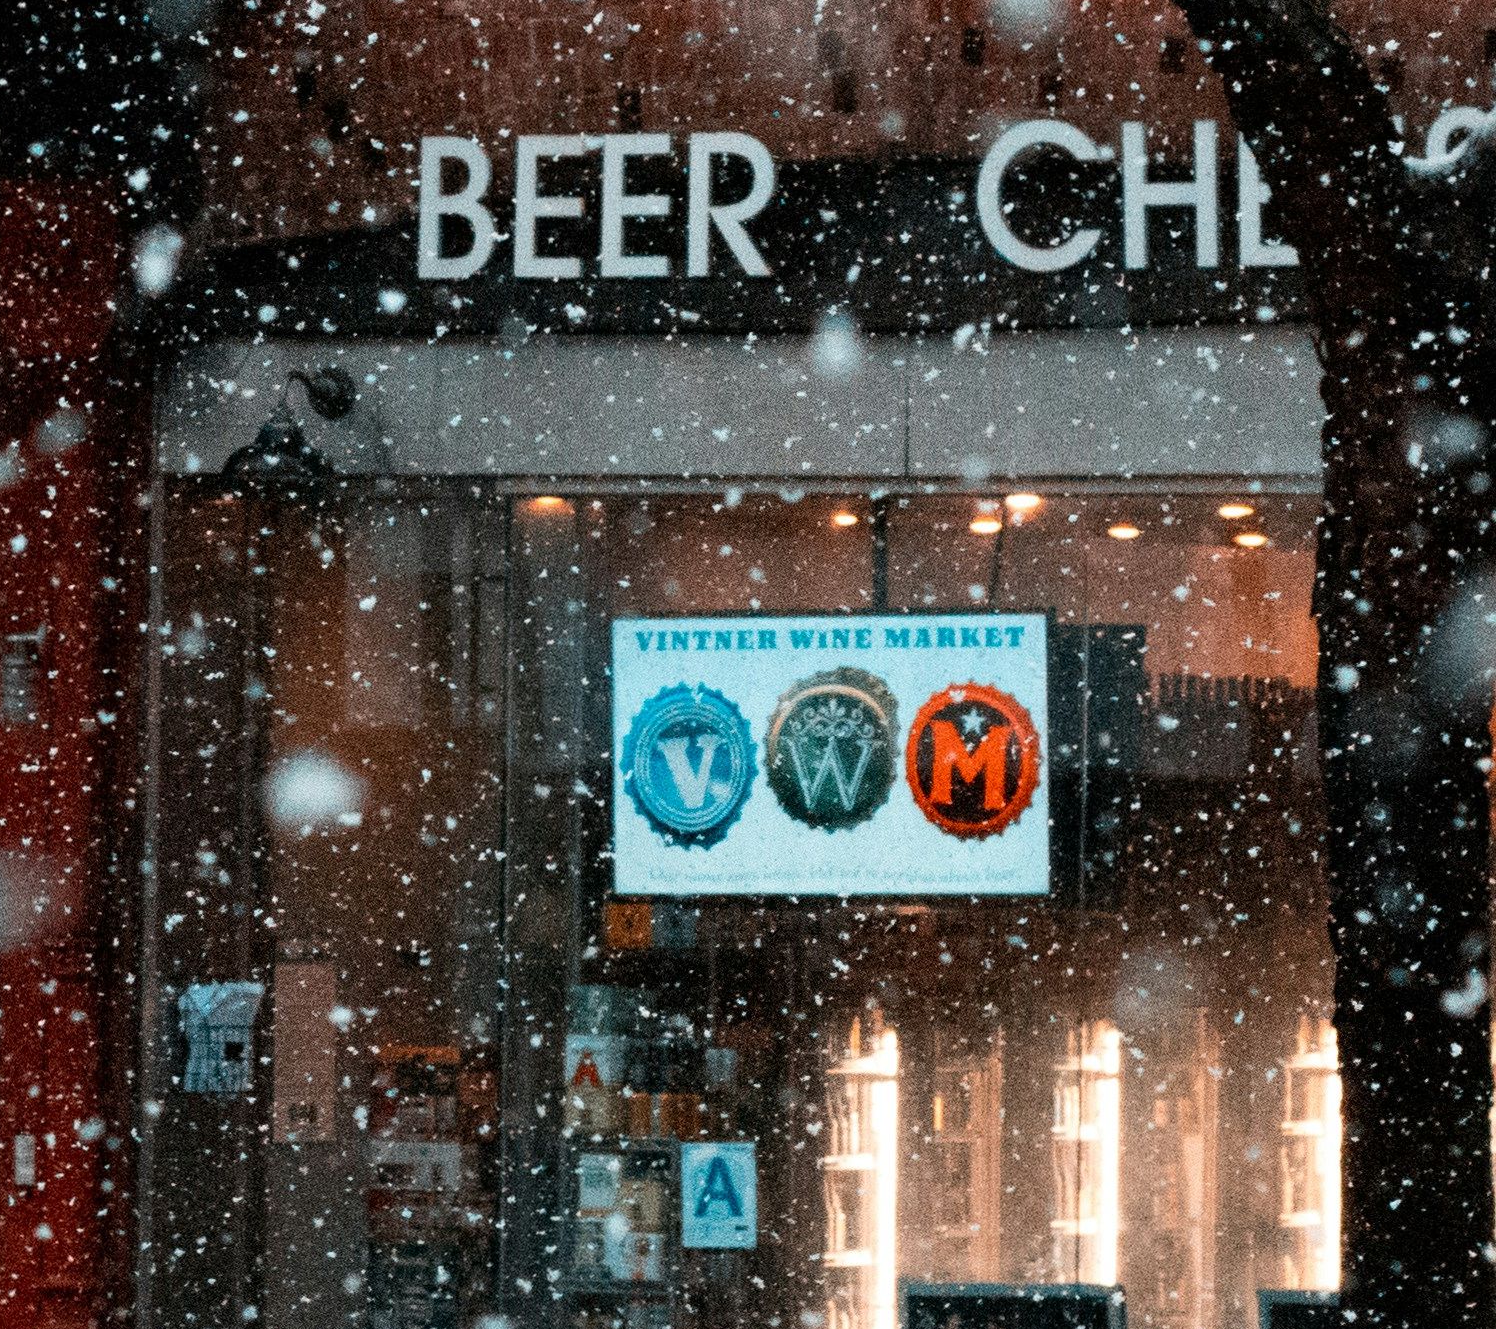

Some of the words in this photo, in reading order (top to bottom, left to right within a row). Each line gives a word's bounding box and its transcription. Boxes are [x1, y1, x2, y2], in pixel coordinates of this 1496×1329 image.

[417, 130, 779, 279] BEER
[635, 627, 778, 654] VINTNER
[787, 627, 873, 651] WINE
[883, 625, 1026, 650] MARKET
[659, 735, 721, 810] V
[785, 735, 884, 812] W
[928, 718, 1013, 812] M
[694, 1156, 745, 1217] A
